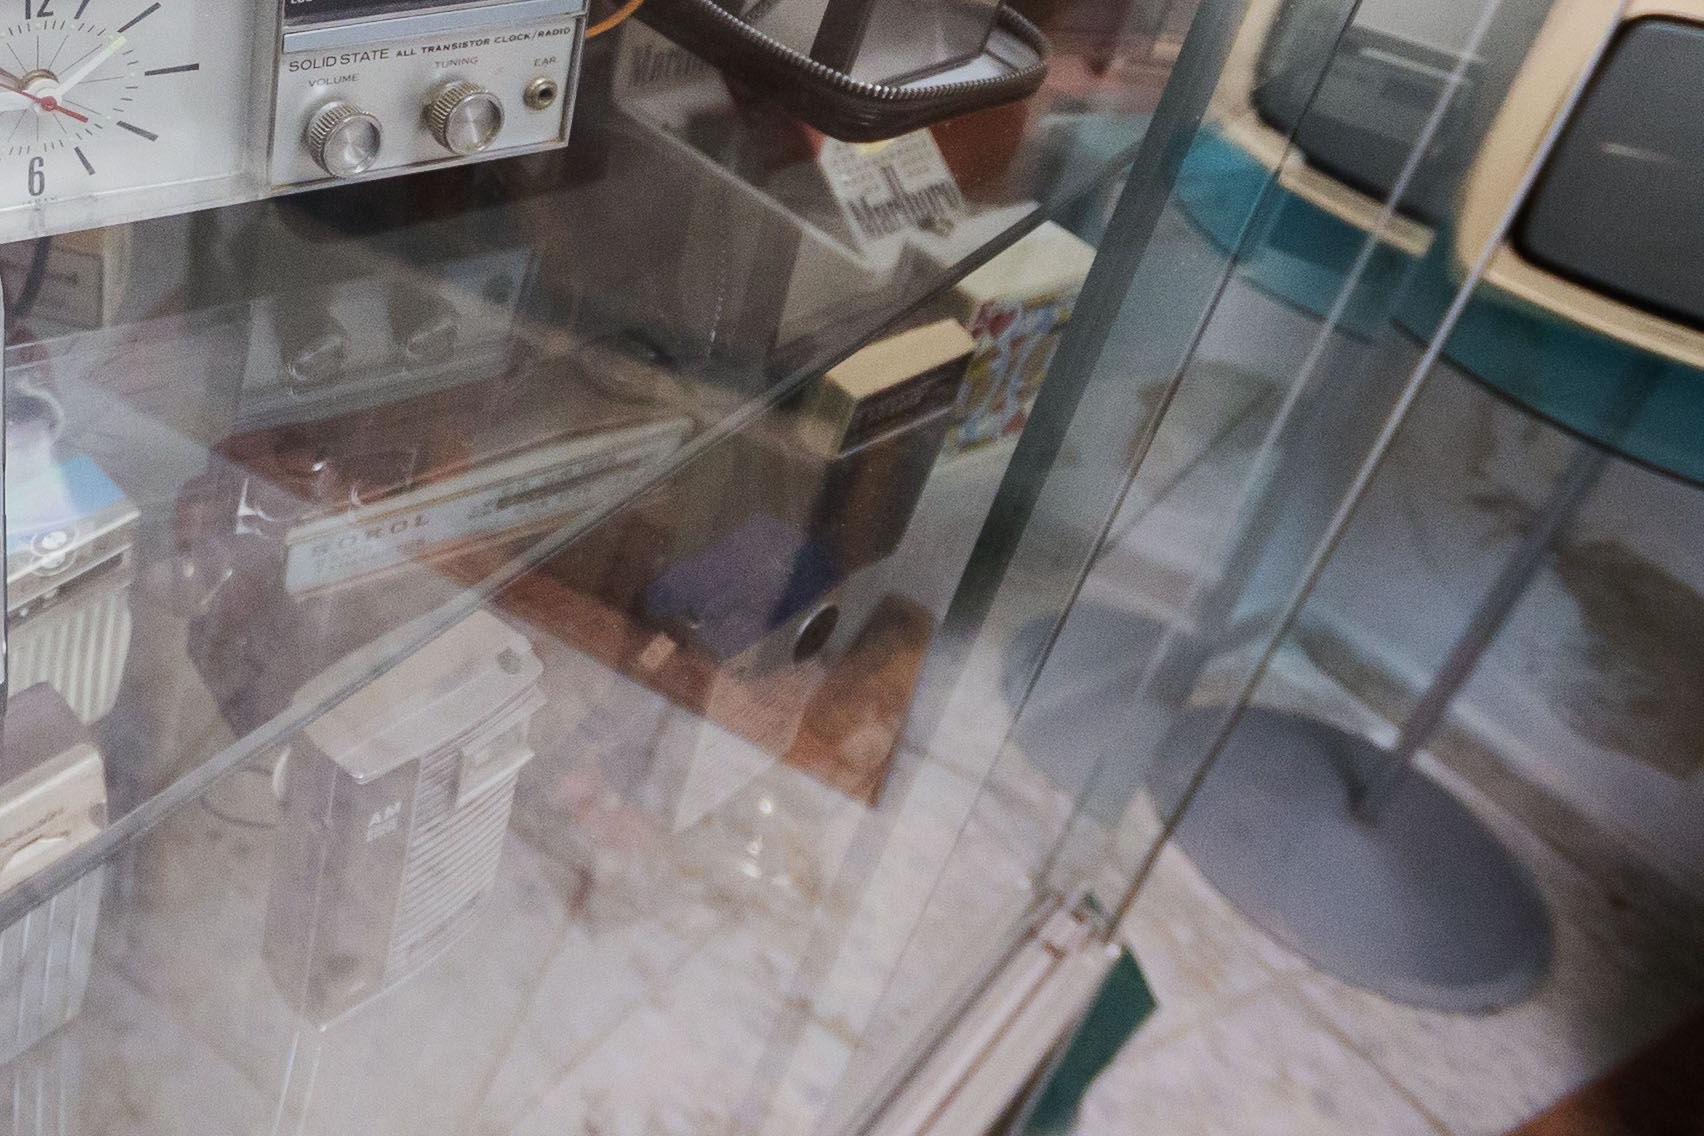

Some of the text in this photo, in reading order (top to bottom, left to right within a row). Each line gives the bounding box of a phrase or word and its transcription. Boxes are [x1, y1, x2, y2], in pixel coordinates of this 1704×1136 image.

[288, 26, 571, 73] SOLID STATE ALL TRANSISTOR CLOCK/RADIO
[434, 55, 479, 70] TUNING
[533, 56, 558, 68] EAR
[308, 72, 361, 87] VOLUME
[28, 156, 45, 197] 6
